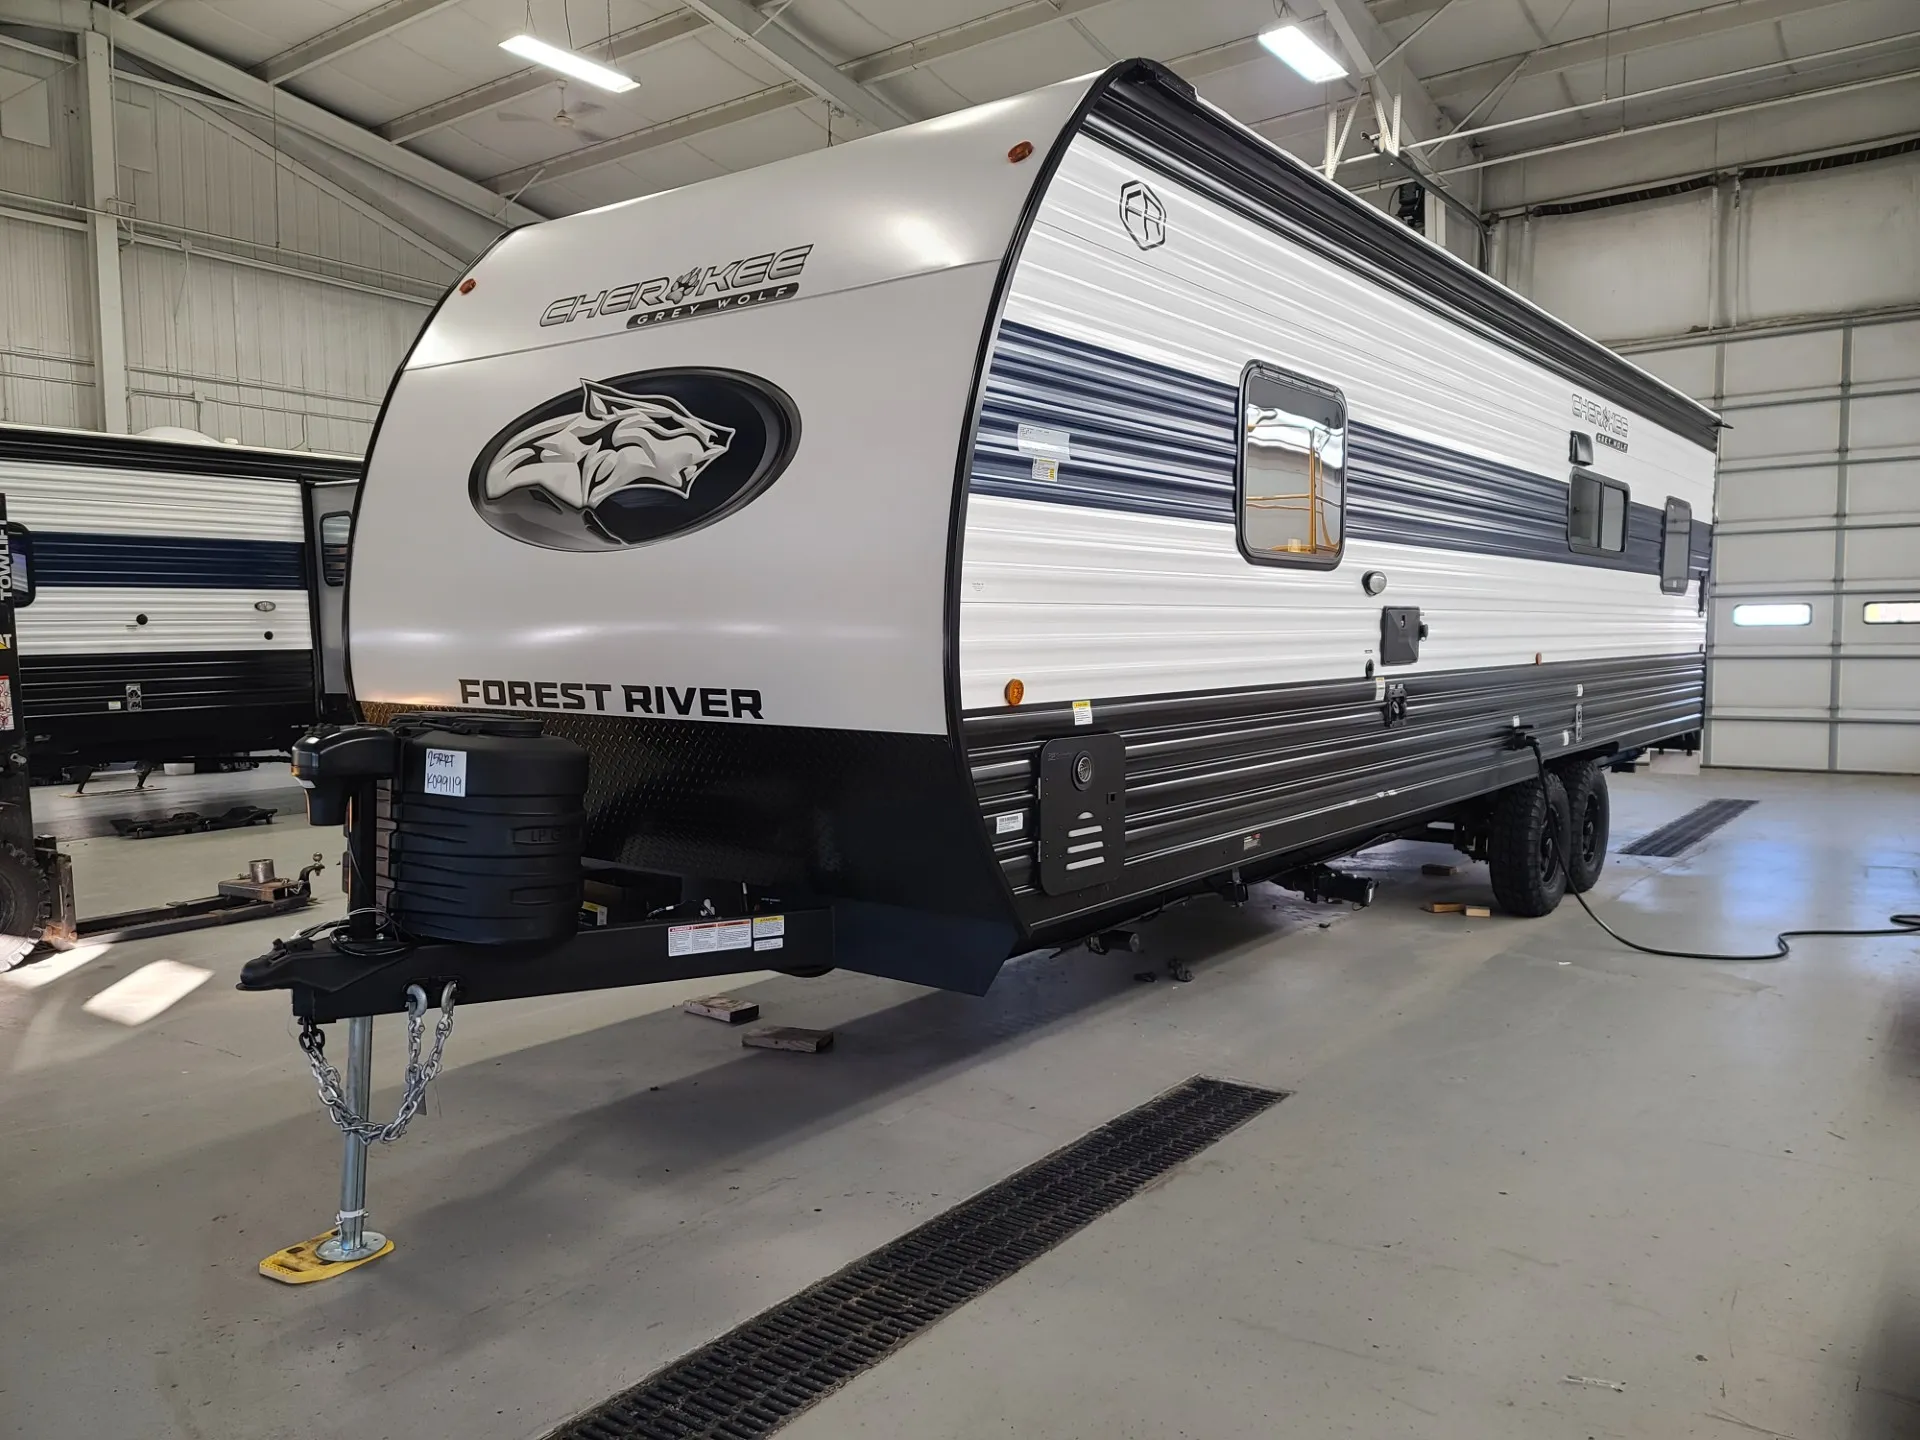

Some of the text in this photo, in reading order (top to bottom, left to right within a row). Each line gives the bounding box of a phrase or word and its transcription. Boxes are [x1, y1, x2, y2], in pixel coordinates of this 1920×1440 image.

[540, 244, 814, 327] CHEROKEE
[637, 286, 787, 325] GREY WOLF
[458, 679, 764, 719] FOREST RIVER
